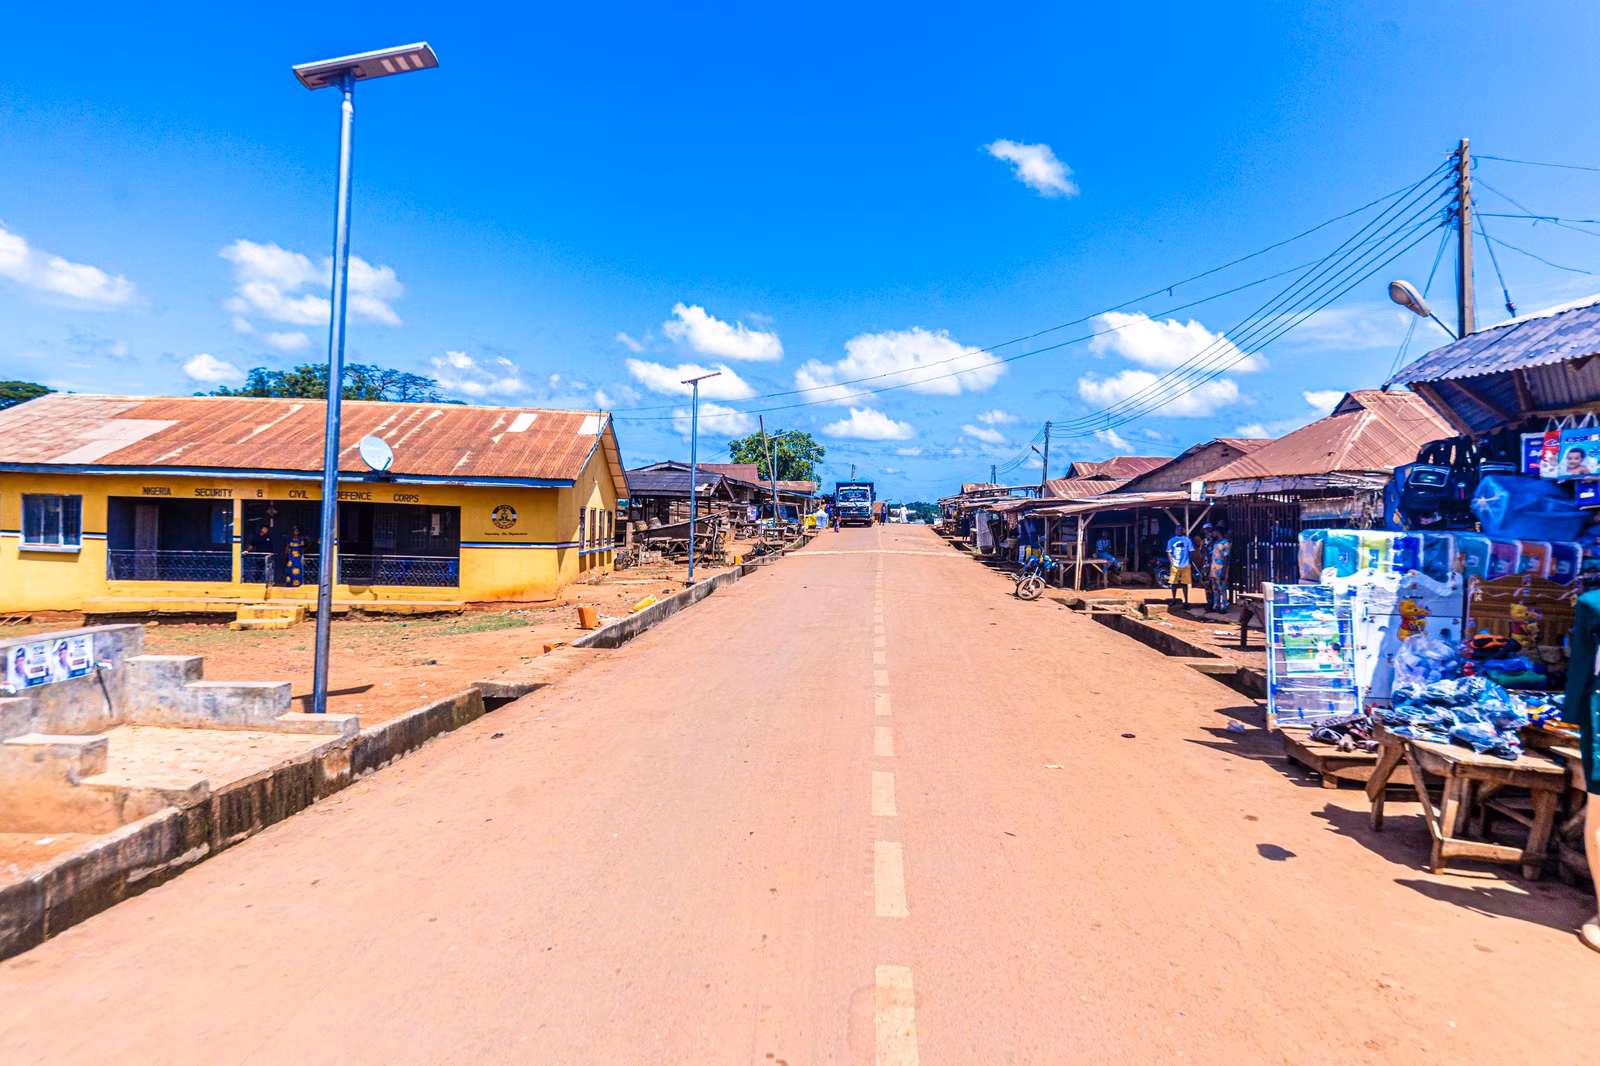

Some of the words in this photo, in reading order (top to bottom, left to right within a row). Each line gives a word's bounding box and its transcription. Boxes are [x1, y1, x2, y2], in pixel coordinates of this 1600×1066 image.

[143, 487, 171, 496] NIGERIA
[194, 488, 233, 497] SECURITY
[289, 490, 308, 499] CIVIL
[393, 494, 419, 503] CORPS
